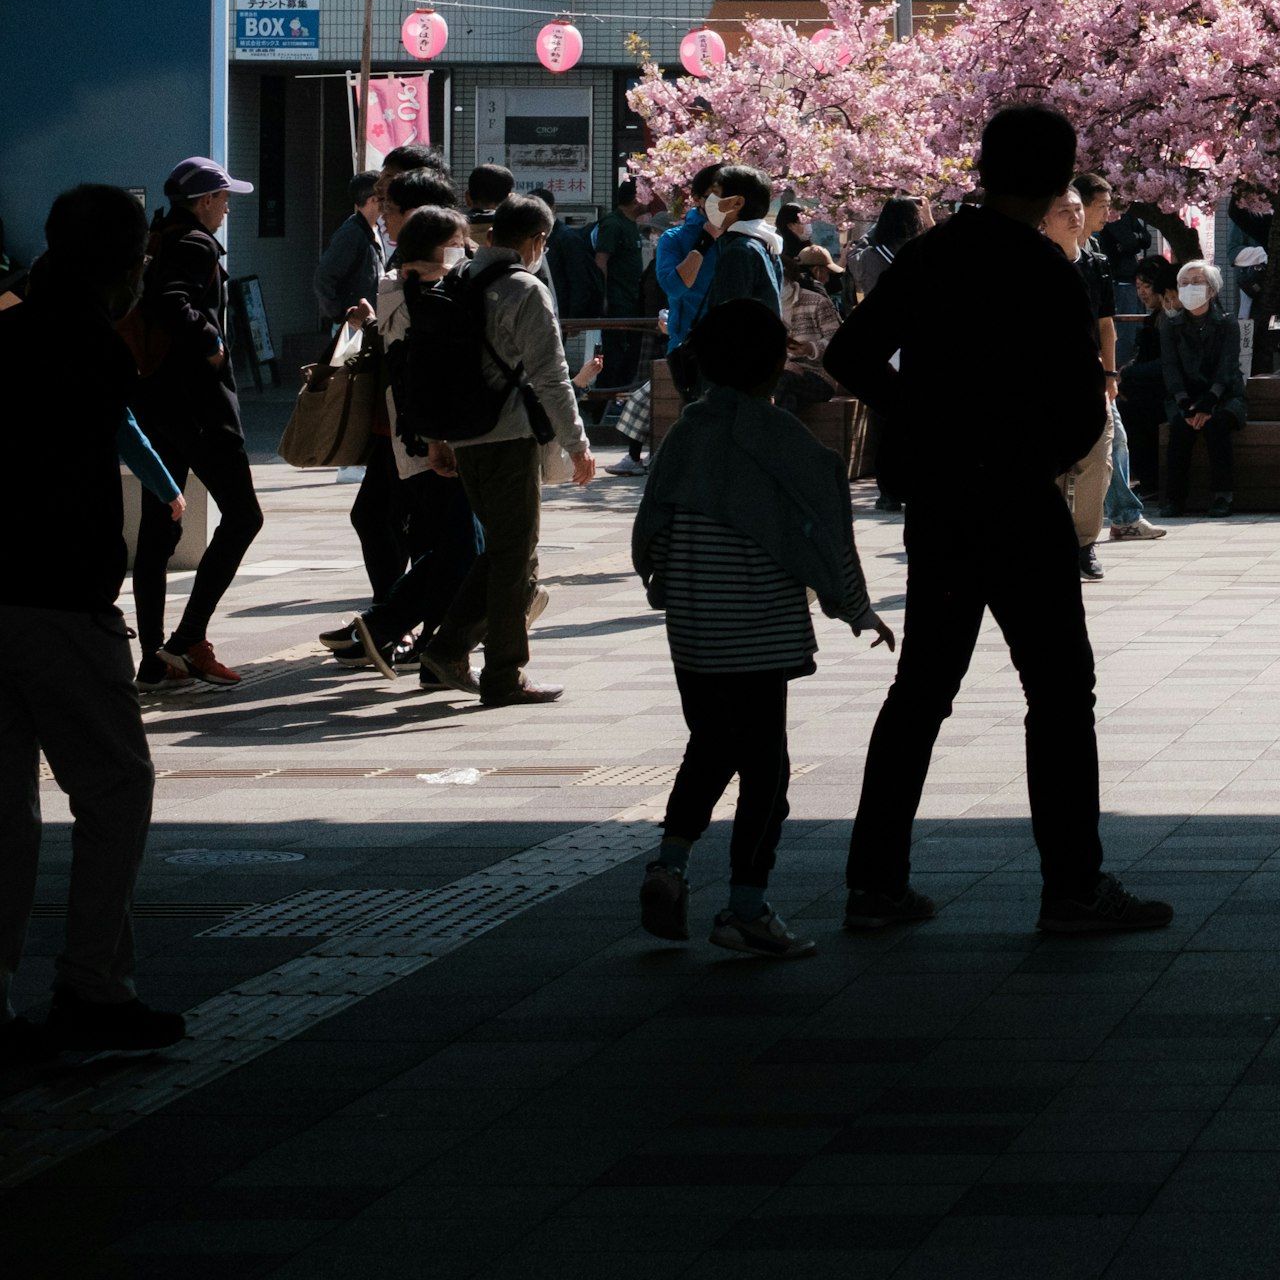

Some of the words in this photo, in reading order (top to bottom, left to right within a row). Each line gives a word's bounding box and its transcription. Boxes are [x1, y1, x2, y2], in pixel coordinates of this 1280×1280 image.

[248, 0, 308, 9] テナント募集
[245, 17, 285, 37] BOX
[547, 178, 586, 193] 桂林
